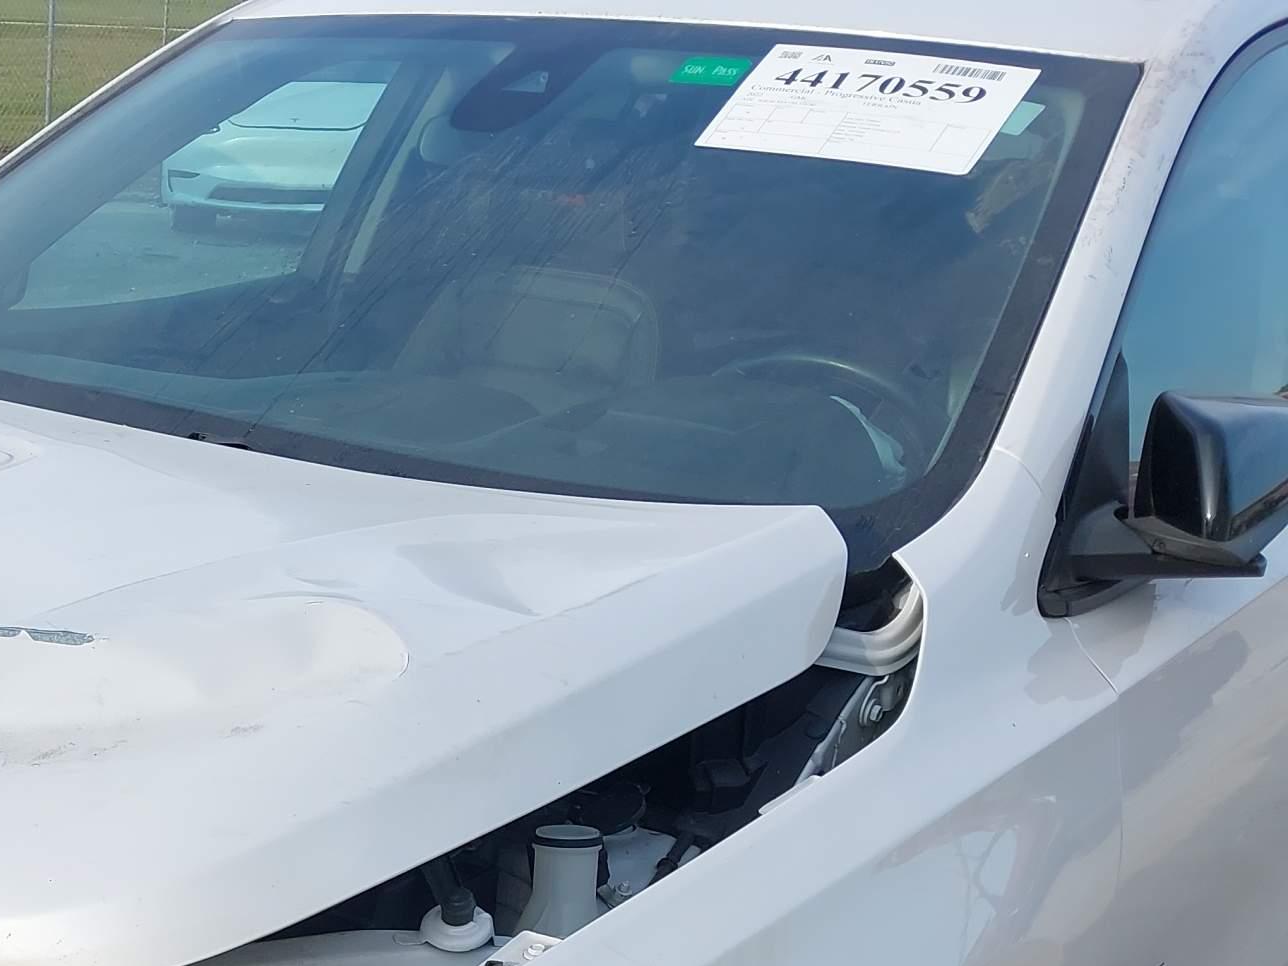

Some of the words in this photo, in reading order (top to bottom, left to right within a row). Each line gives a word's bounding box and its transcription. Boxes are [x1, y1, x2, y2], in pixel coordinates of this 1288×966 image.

[751, 85, 814, 95] Commercial
[825, 90, 885, 102] Progressive
[774, 67, 987, 104] 44170559
